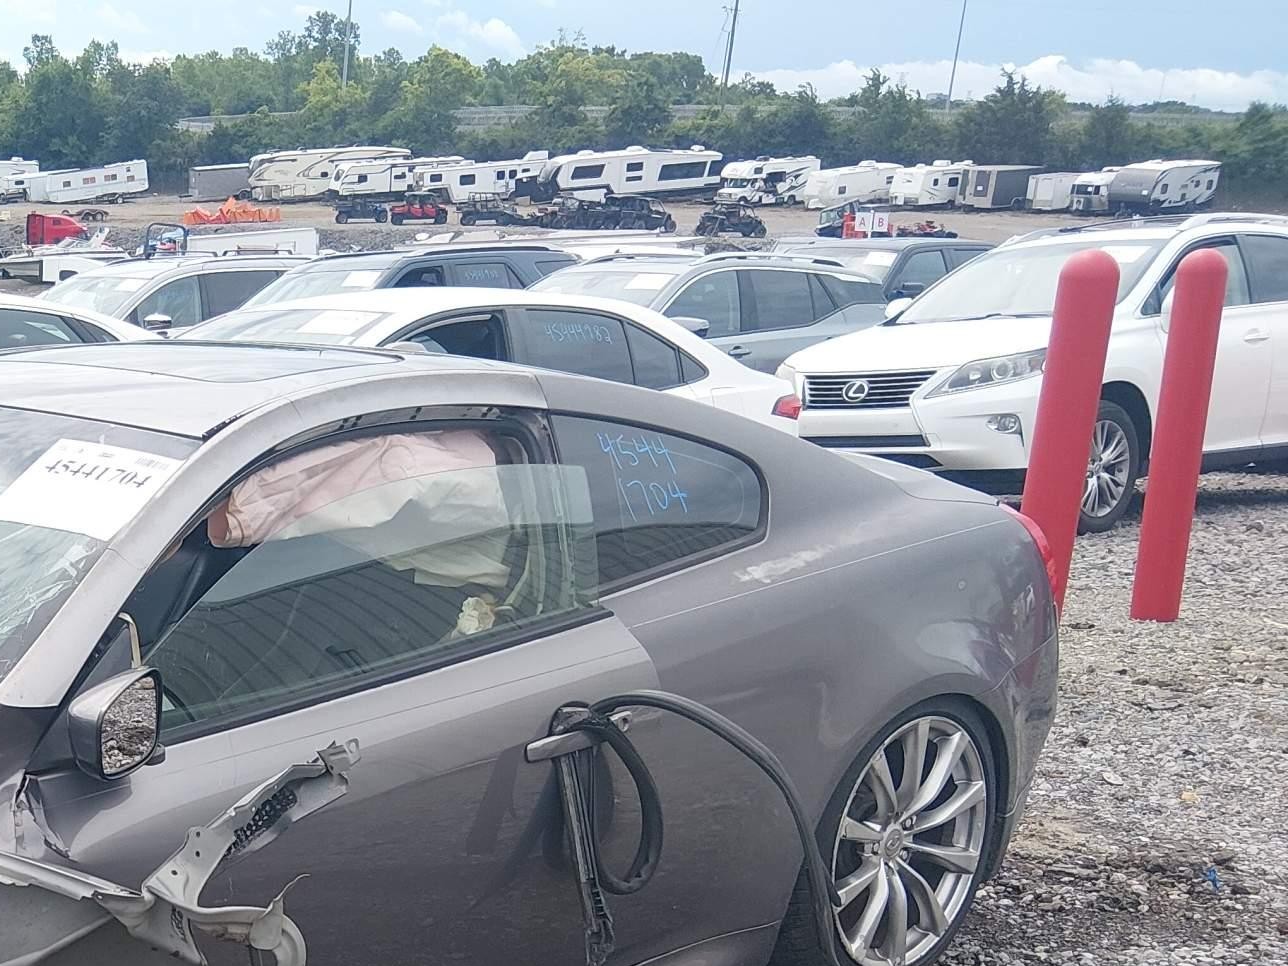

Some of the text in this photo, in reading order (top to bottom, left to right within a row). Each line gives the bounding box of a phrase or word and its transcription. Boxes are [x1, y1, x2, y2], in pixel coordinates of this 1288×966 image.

[859, 217, 866, 227] A
[878, 217, 884, 227] B
[596, 432, 677, 475] 4544
[45, 458, 152, 488] 45441704
[618, 478, 688, 522] 1704
